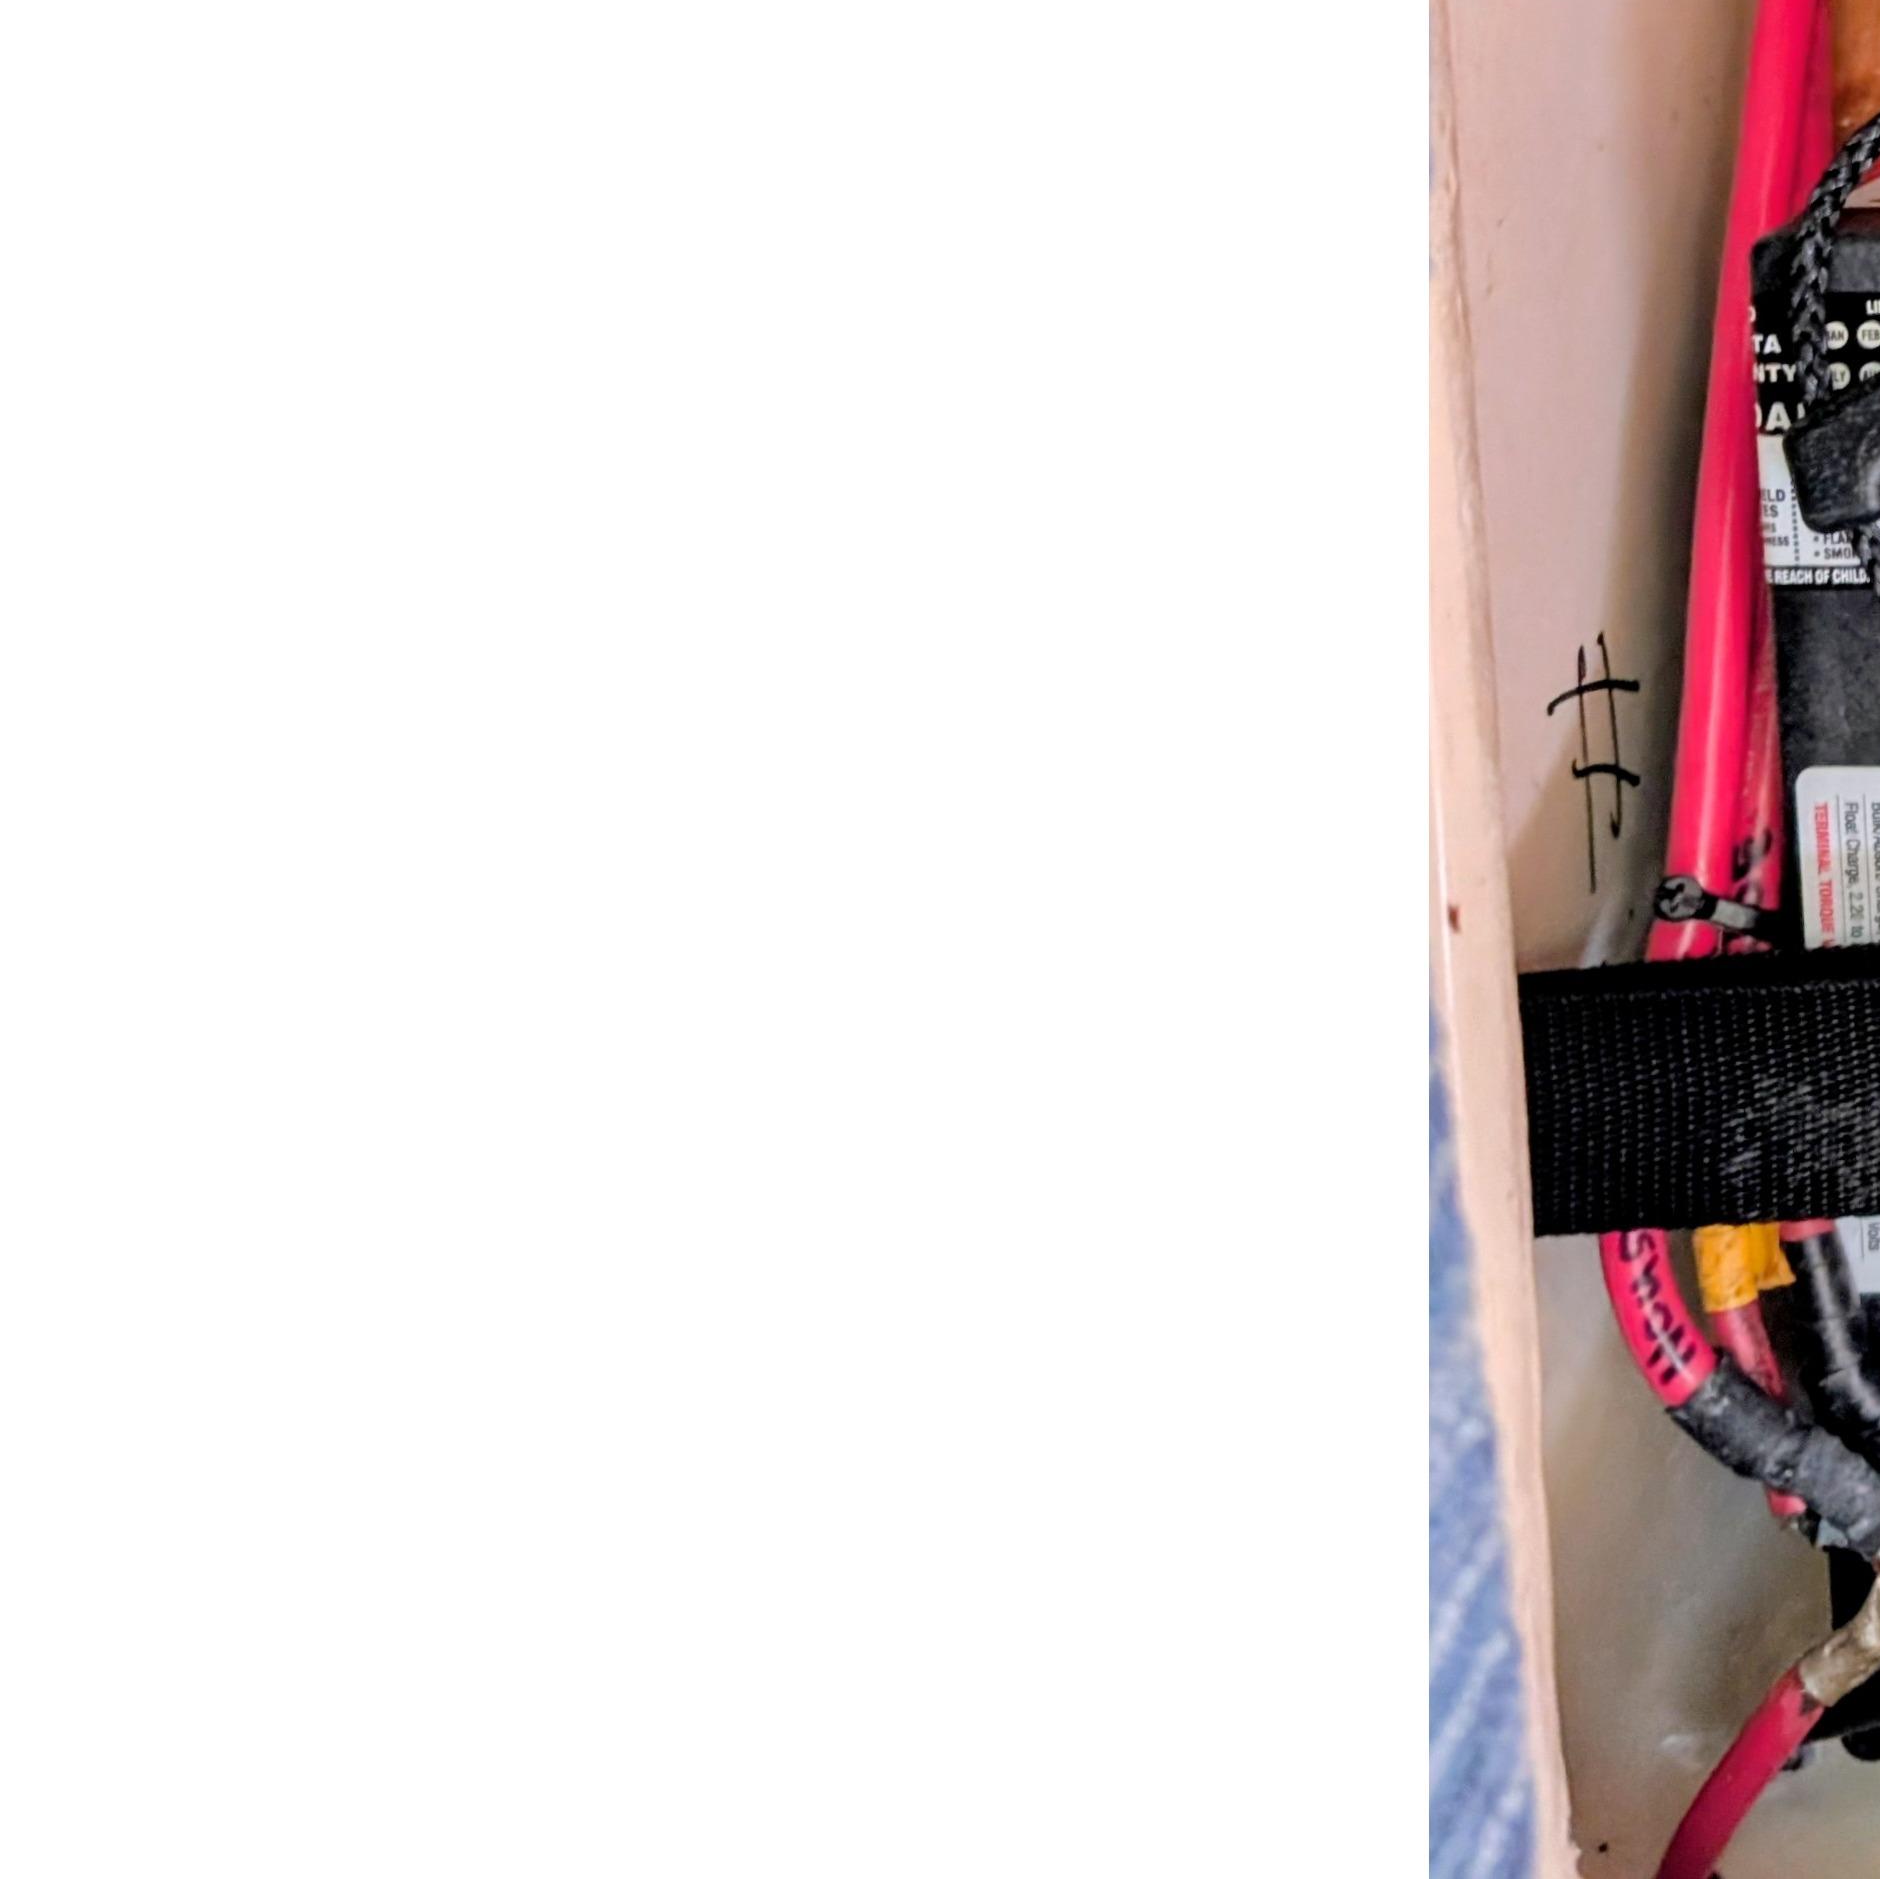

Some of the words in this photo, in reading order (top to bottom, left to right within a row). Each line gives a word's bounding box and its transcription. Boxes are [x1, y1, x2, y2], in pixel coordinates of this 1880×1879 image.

[1861, 328, 1880, 341] FEB
[1775, 569, 1813, 585] REACH
[1815, 569, 1830, 584] OF
[1844, 802, 1859, 834] Float
[1814, 802, 1831, 875] TERMINAL
[1819, 880, 1835, 933] TORQUE
[1851, 926, 1864, 938] to
[1868, 1221, 1880, 1251] Volts
